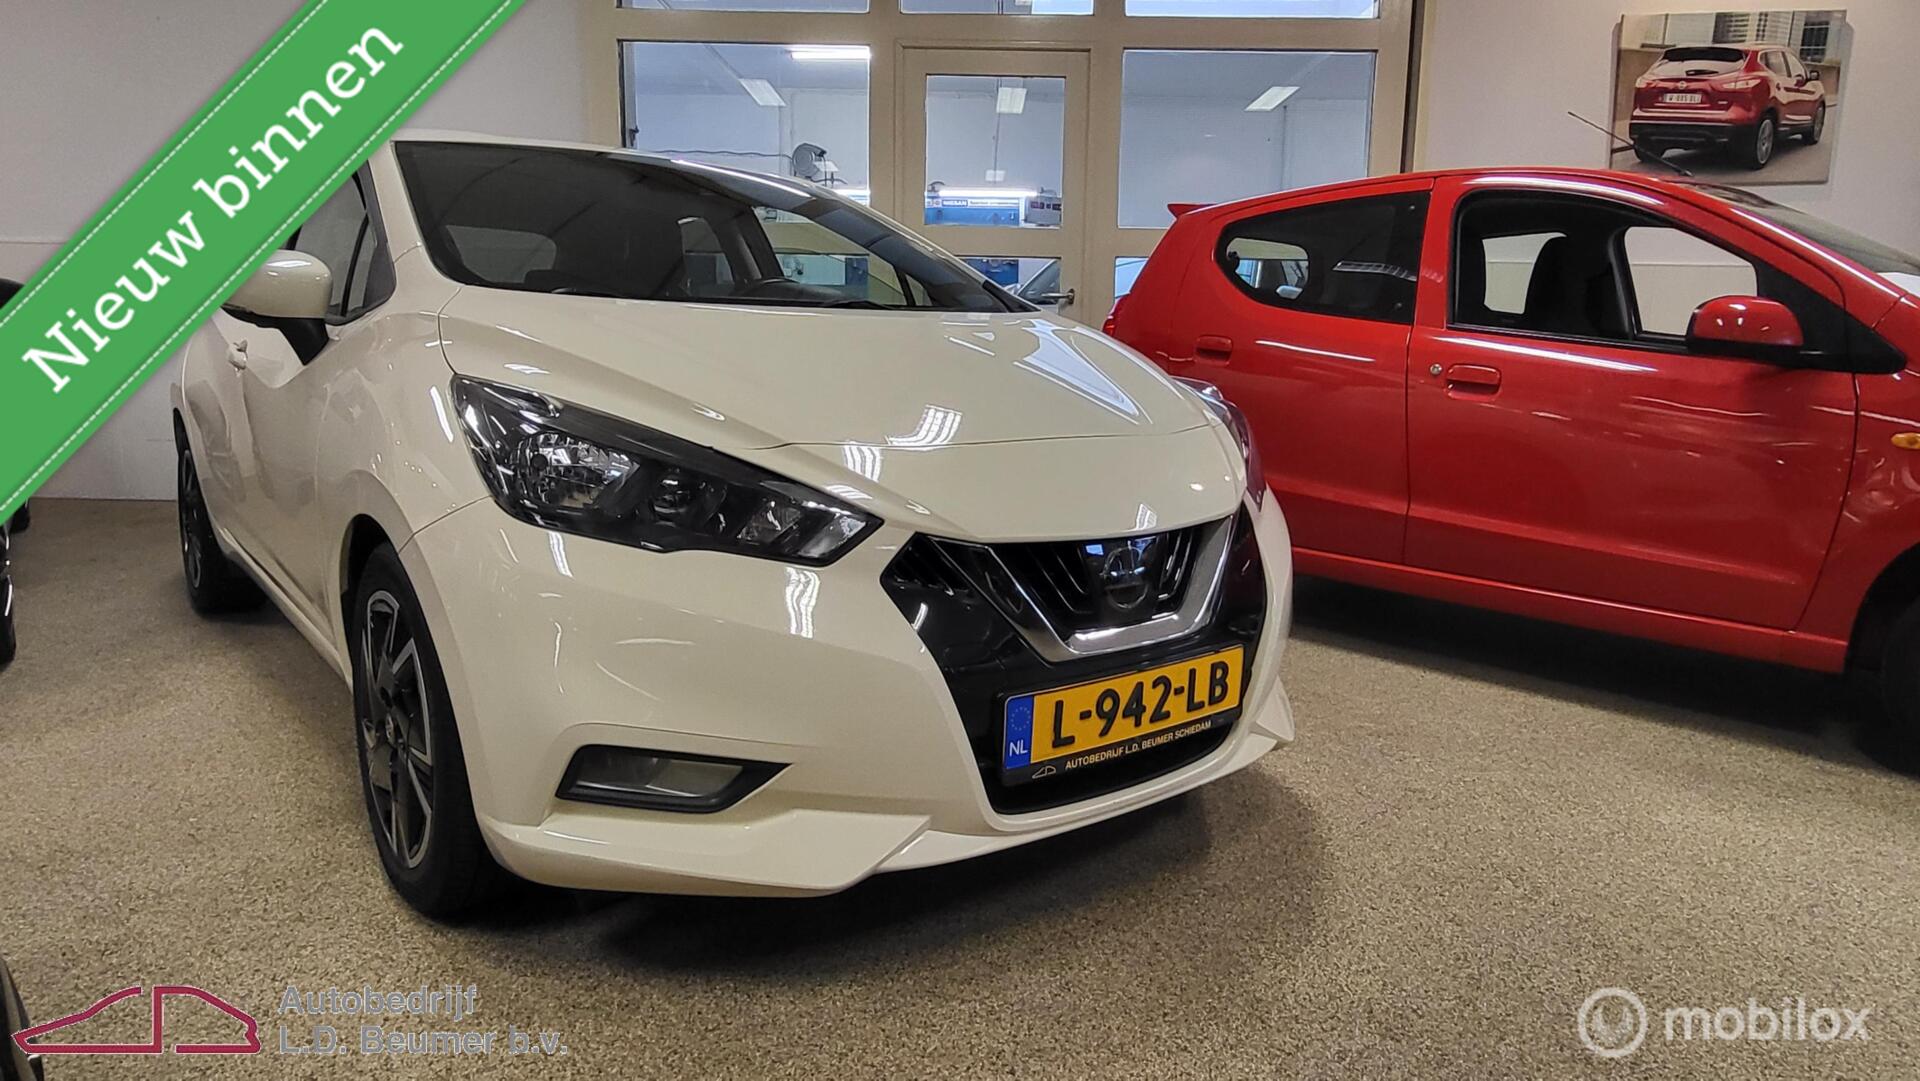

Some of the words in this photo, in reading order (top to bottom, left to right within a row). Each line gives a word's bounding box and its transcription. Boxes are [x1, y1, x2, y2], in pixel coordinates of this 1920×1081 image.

[1051, 660, 1230, 749] L-942-LB
[1008, 740, 1029, 758] NL
[1065, 748, 1124, 770] AUTOBEDRIJF
[1125, 743, 1140, 755] L.D.
[1142, 732, 1174, 749] BEUMER
[1174, 720, 1212, 740] SCHIEDAM
